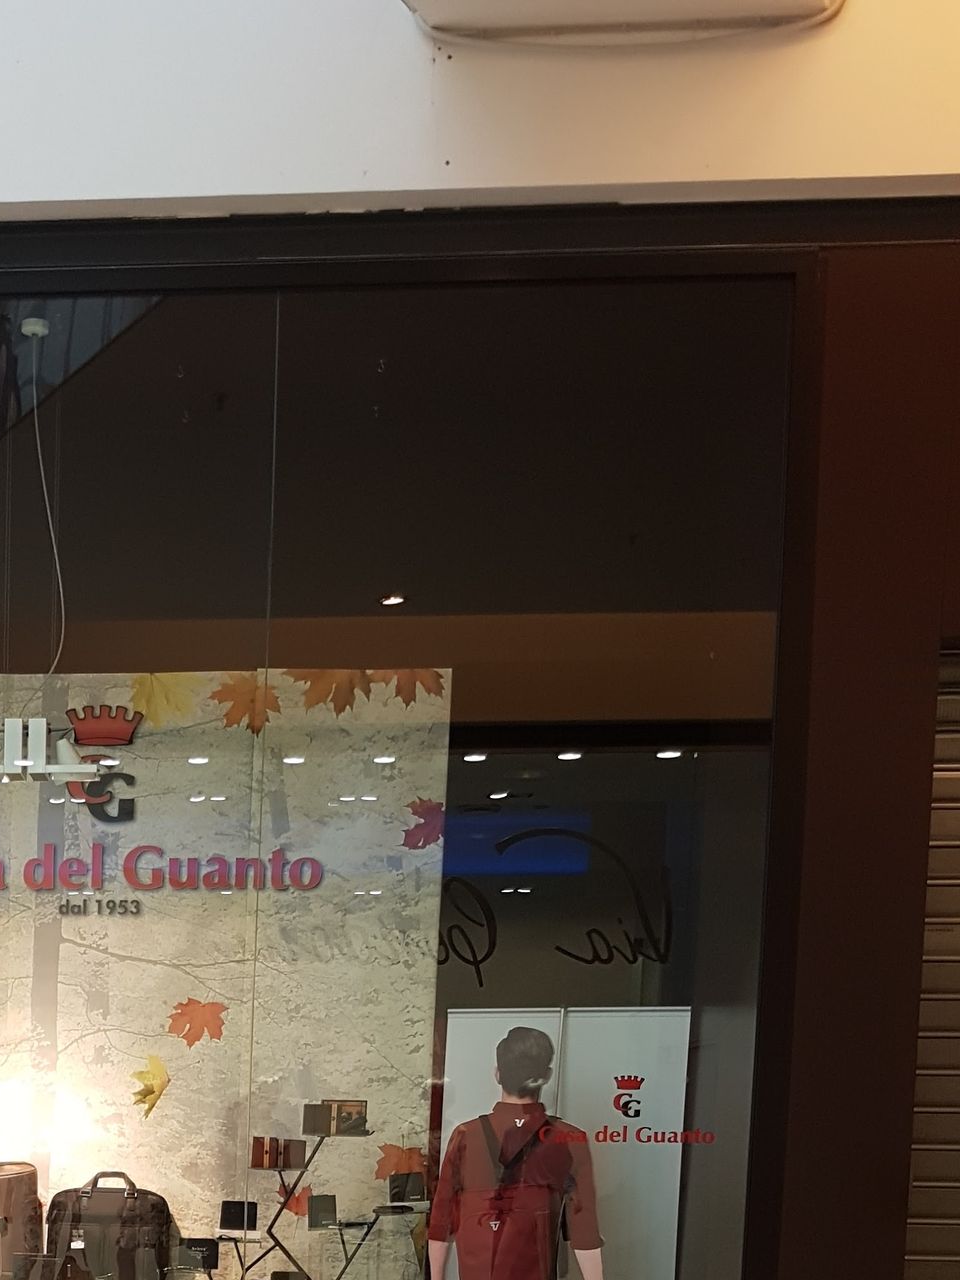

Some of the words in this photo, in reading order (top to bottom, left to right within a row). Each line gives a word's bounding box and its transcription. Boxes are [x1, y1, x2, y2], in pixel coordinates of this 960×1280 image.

[23, 842, 105, 891] del
[122, 844, 324, 891] Guanto
[58, 899, 87, 916] dal
[95, 899, 141, 916] 1953
[595, 1125, 628, 1143] del
[635, 1126, 716, 1144] Guanto
